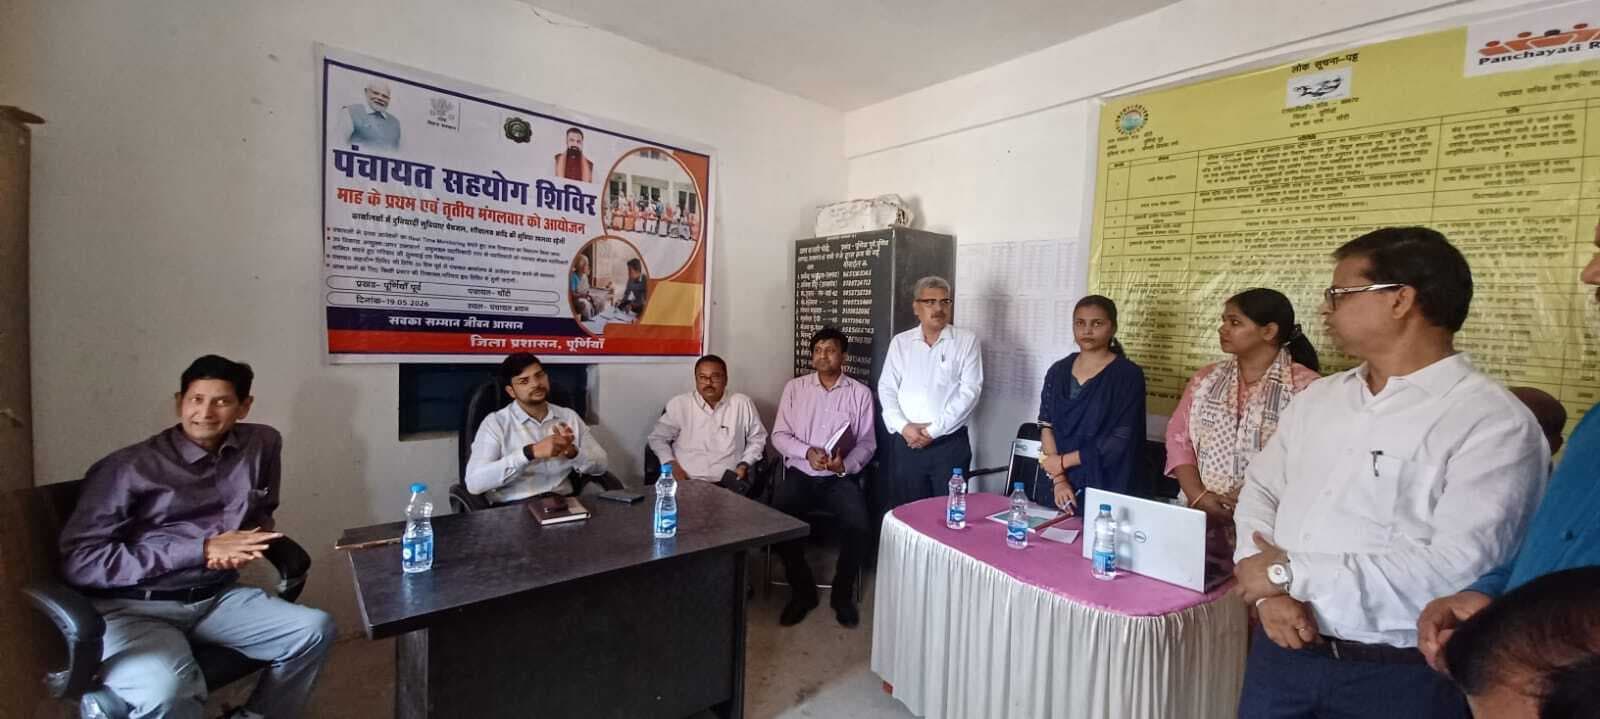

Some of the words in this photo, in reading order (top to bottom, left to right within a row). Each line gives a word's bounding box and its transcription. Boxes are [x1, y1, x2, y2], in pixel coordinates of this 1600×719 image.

[1478, 43, 1581, 65] Panchayati
[333, 144, 435, 189] पंचायत
[442, 170, 529, 205] सहयोग
[536, 179, 597, 216] शिविर
[337, 187, 364, 204] माह
[367, 188, 382, 206] के
[385, 194, 417, 211] प्रथम
[420, 197, 440, 214] एवं
[442, 200, 475, 221] तृतीय
[478, 205, 524, 226] मंगलवार
[527, 213, 541, 229] को
[543, 217, 586, 235] आयोजन
[388, 316, 422, 327] सबका
[424, 318, 460, 329] सम्मान
[463, 316, 490, 330] जीवन
[492, 320, 524, 330] आसान
[470, 334, 507, 348] जिला
[510, 337, 562, 351] प्रशासन,
